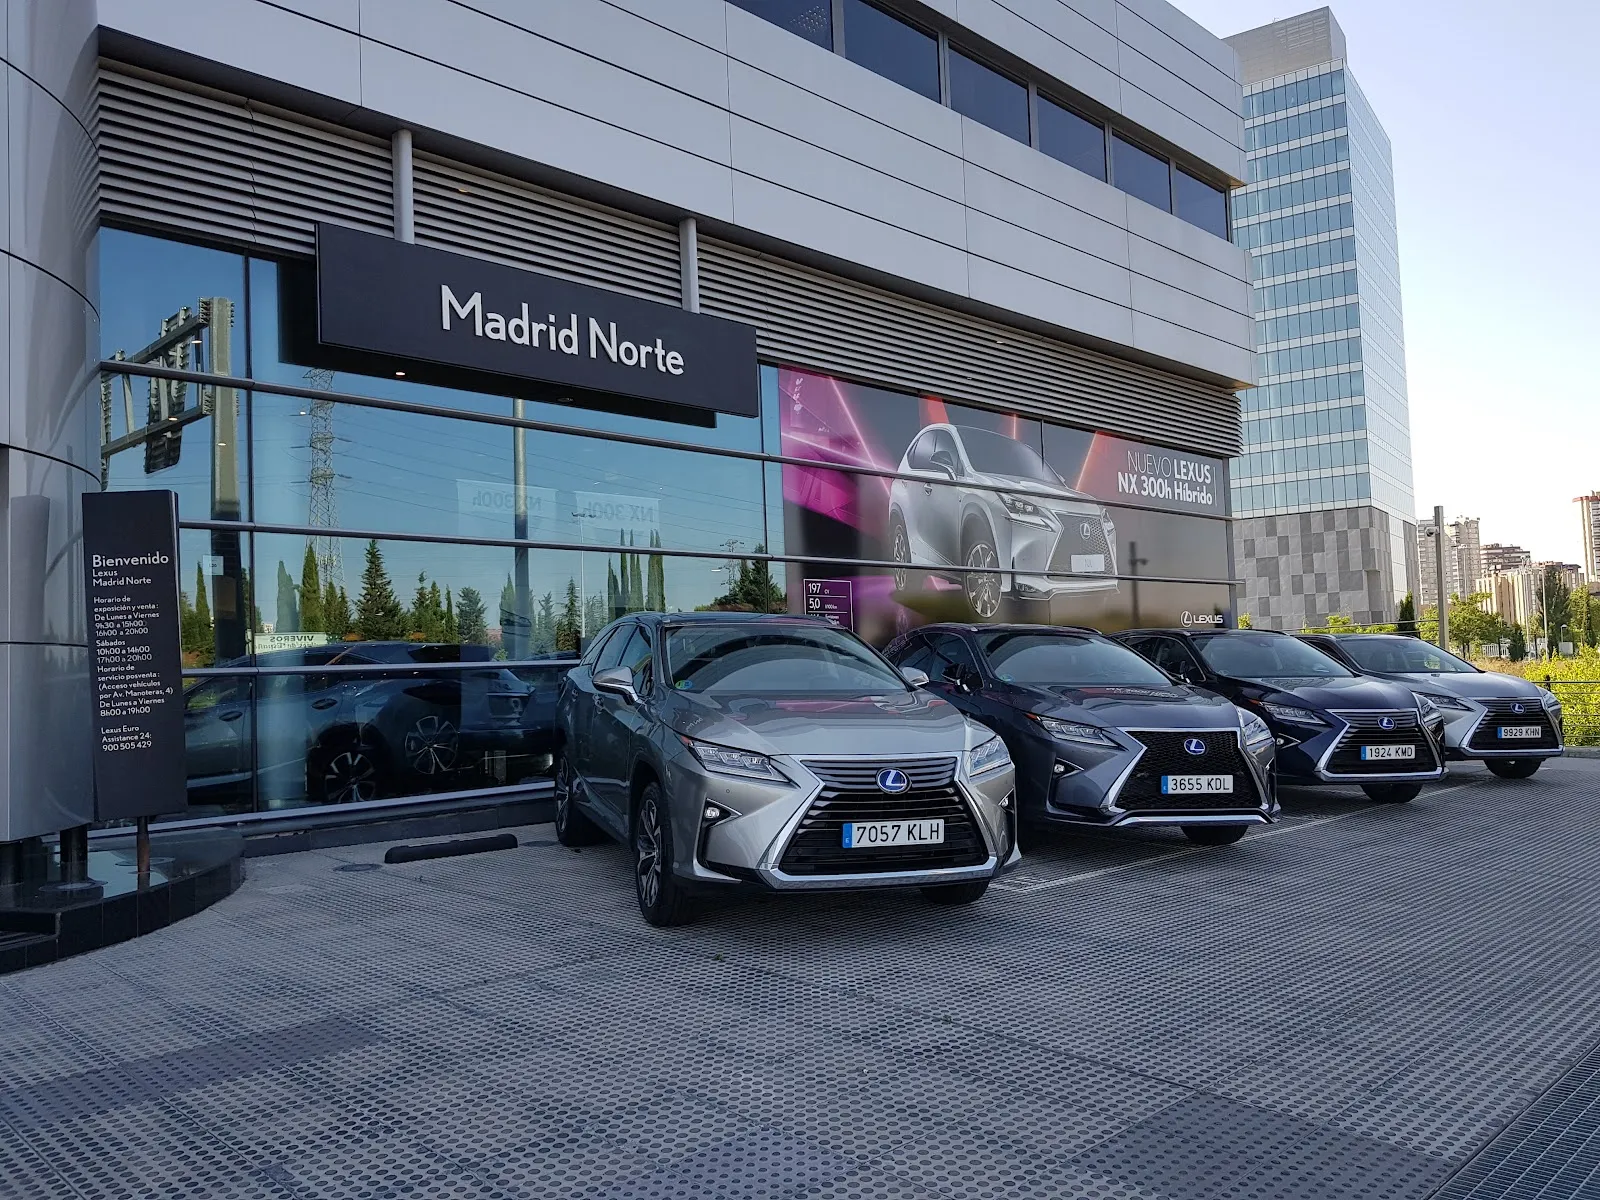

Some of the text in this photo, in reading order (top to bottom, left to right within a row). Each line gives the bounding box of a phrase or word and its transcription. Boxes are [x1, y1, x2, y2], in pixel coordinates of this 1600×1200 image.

[441, 284, 684, 375] Madrid Norte
[1128, 450, 1211, 484] NUEVO LEXUS
[1118, 472, 1212, 505] NX 300h Híbrido
[92, 551, 169, 567] Bienvenido
[93, 569, 118, 577] Lexus
[93, 577, 151, 586] Madrid Norte
[808, 583, 821, 593] 197
[94, 605, 131, 613] exposición
[809, 598, 820, 610] 5,0
[1193, 614, 1223, 624] LEXUS
[1504, 728, 1540, 736] 9929 KHN
[1370, 747, 1412, 758] 1924 KMD
[1171, 778, 1230, 790] 3655 KDL
[857, 823, 939, 844] 7057 KLH
